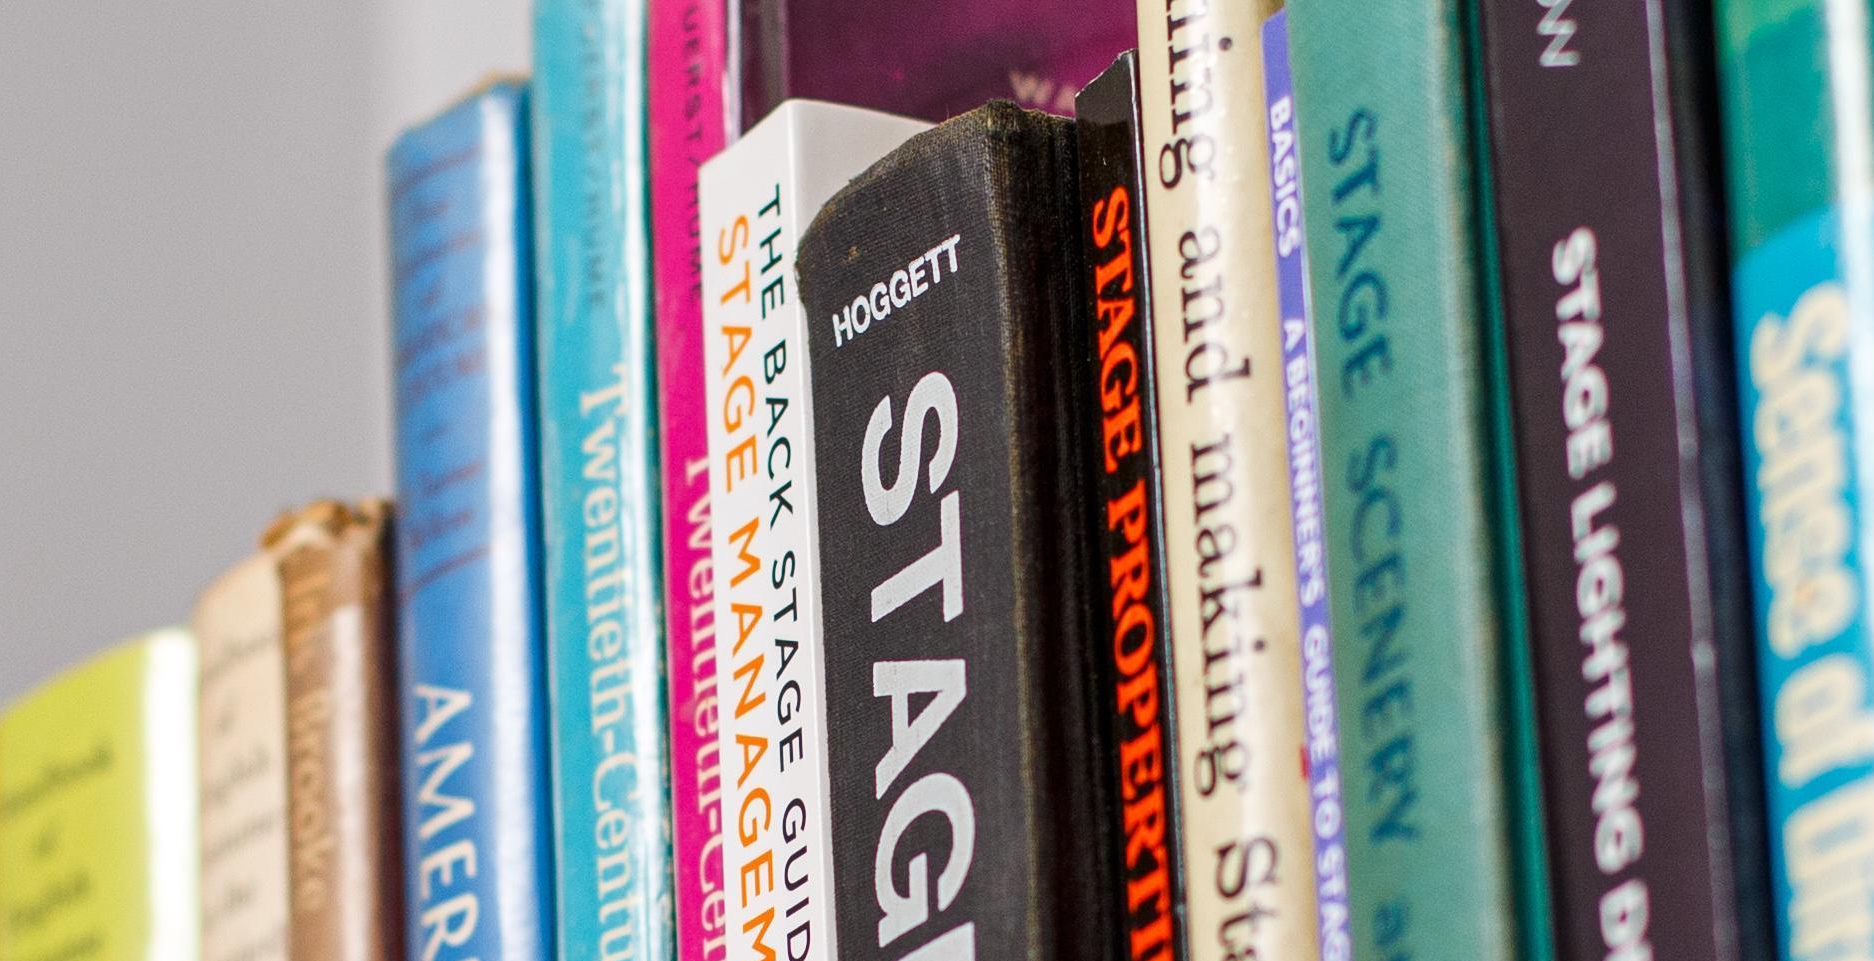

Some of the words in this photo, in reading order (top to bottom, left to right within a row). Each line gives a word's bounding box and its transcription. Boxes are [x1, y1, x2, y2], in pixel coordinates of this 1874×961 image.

[757, 183, 787, 320] THE
[1269, 95, 1303, 258] BASICS
[1330, 106, 1393, 401] STAGE
[717, 214, 759, 493] STAGE
[832, 234, 961, 347] HOGGETT
[1092, 185, 1146, 474] STAGE
[1178, 225, 1253, 404] and
[1282, 318, 1303, 350] A
[1552, 226, 1615, 480] STAGE
[763, 338, 795, 530] BACK
[1750, 279, 1861, 659] Sense
[770, 550, 805, 773] STAGE
[1189, 432, 1266, 799] making
[1302, 624, 1336, 762] GUIDE
[1347, 434, 1421, 844] SCENERY
[1570, 481, 1645, 875] LIGHTING
[1309, 767, 1341, 840] TO
